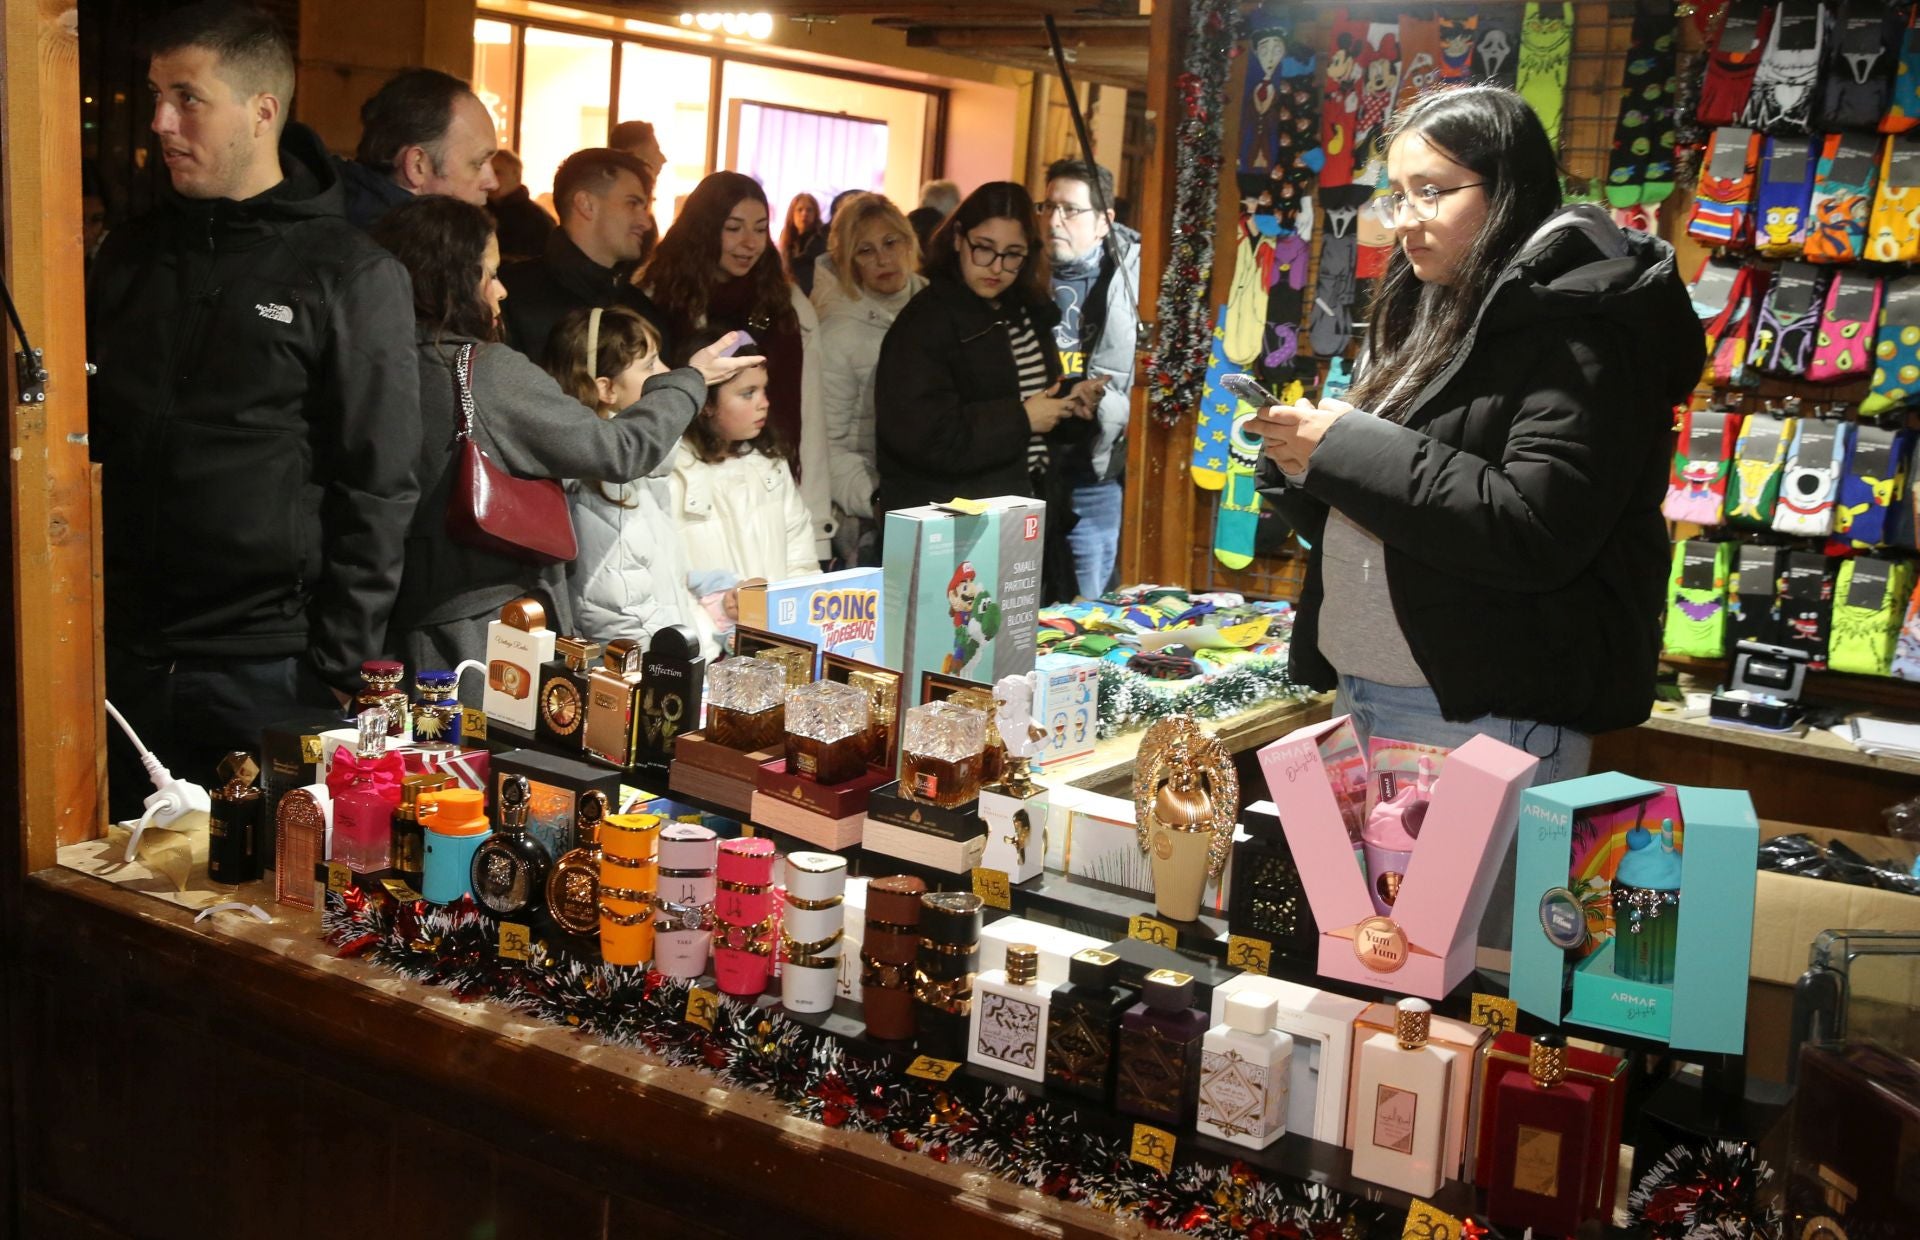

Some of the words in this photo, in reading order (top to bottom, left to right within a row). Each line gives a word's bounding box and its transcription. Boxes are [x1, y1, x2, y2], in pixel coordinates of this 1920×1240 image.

[255, 303, 280, 315] NORTH
[258, 310, 280, 321] FACE
[1013, 560, 1037, 575] SMALL
[1003, 576, 1036, 593] PARTICLE
[812, 594, 876, 621] SOINC
[1001, 593, 1035, 611] BUILDING
[822, 621, 836, 632] THE
[1007, 610, 1034, 627] BLOCKS
[648, 663, 682, 678] Affection
[1263, 742, 1312, 767] ARMAF
[1523, 803, 1569, 827] ARMAF
[1365, 930, 1390, 946] Yum
[1372, 944, 1397, 960] Yum
[1611, 992, 1657, 1008] ARMAF
